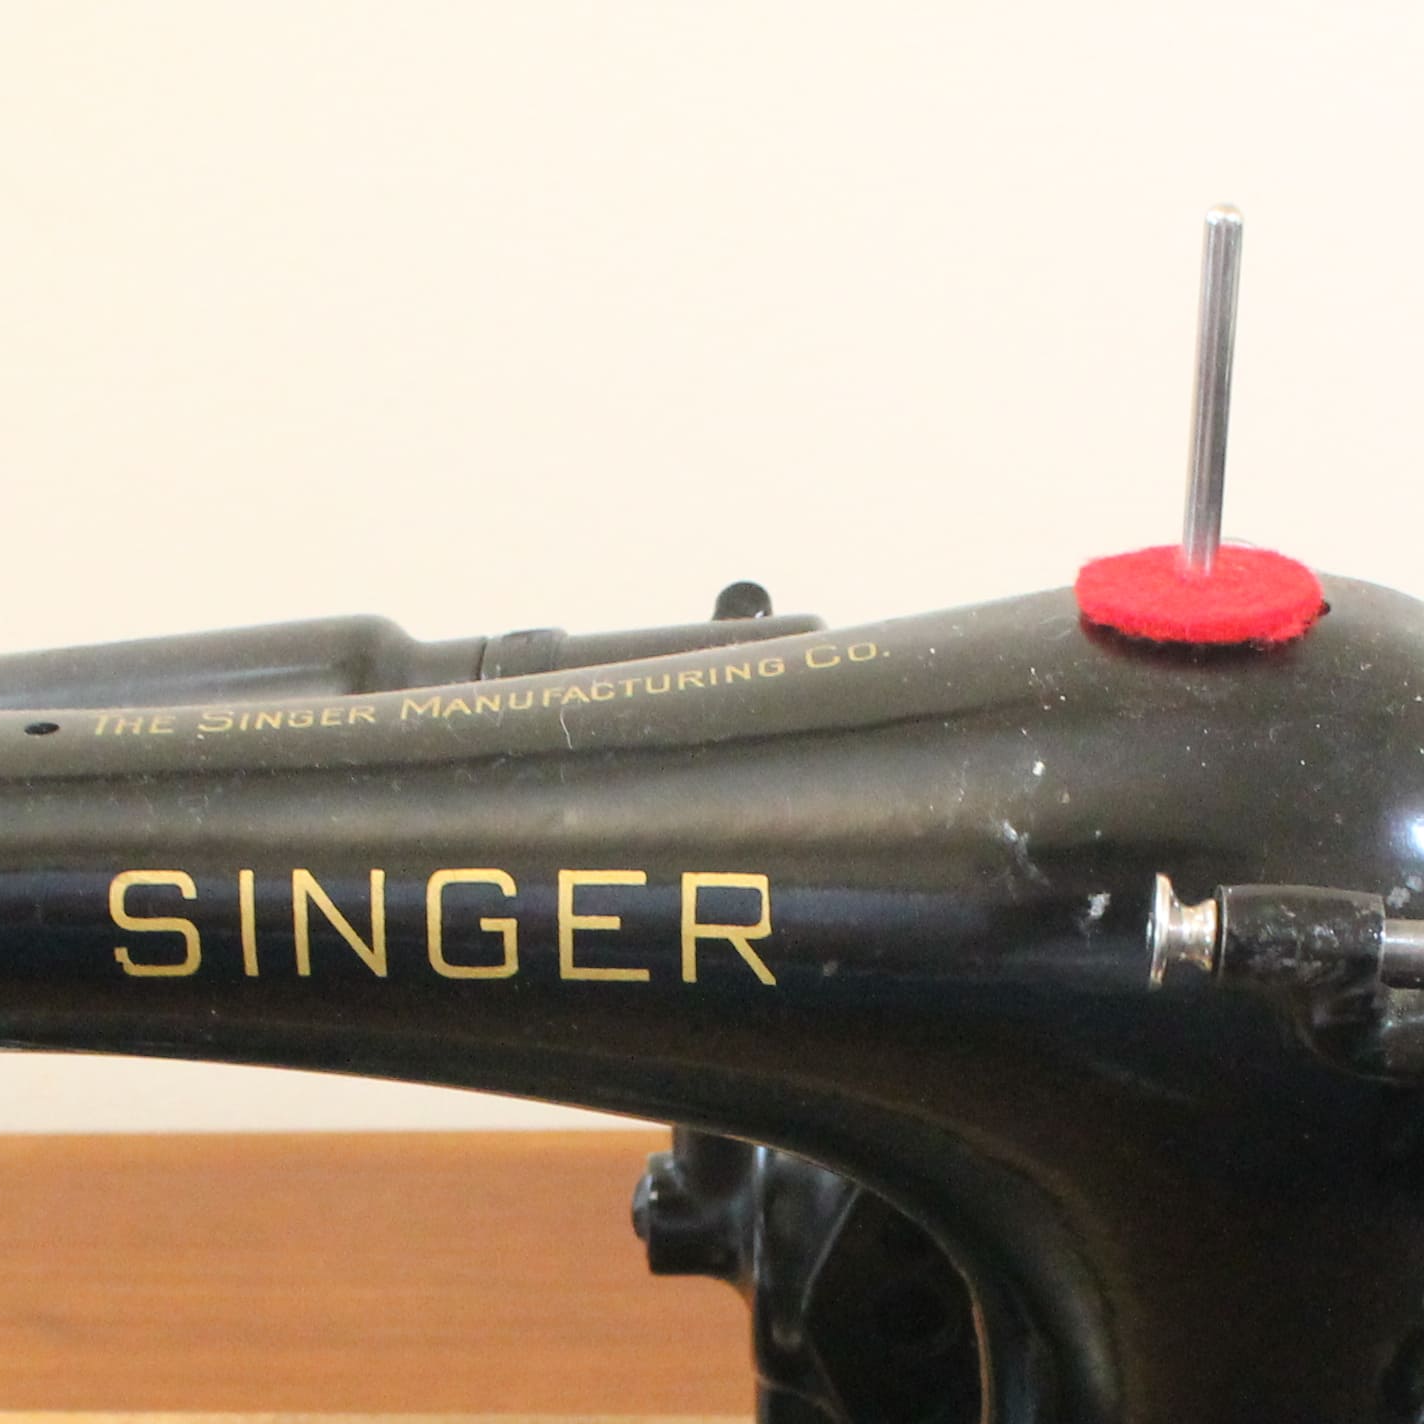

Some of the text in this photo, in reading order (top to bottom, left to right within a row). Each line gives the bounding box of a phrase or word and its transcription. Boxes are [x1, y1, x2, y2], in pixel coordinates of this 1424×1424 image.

[93, 710, 175, 736] THE
[196, 704, 376, 733] SINGER
[400, 656, 786, 720] MANUFACTURING
[108, 867, 777, 986] SINGER
